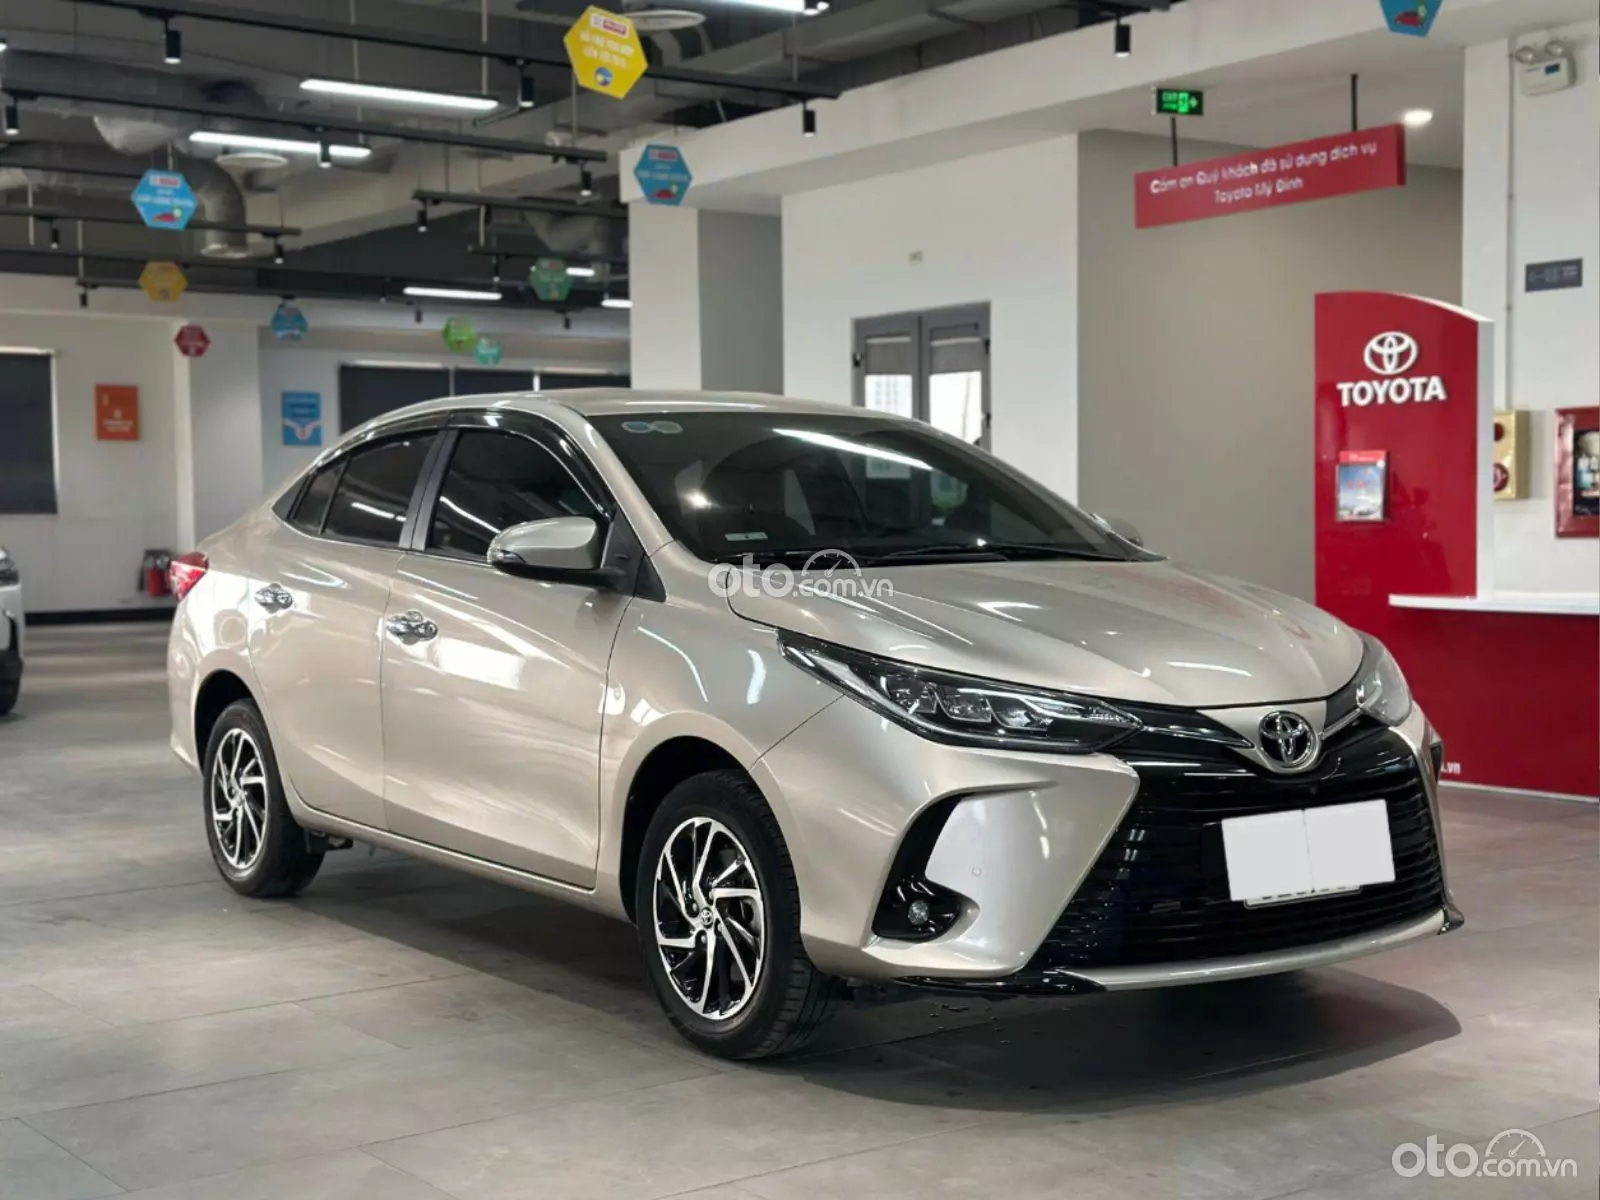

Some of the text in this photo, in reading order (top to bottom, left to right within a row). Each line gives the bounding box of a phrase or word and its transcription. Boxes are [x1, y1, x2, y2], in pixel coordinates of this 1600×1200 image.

[1222, 162, 1258, 181] khách
[1215, 187, 1253, 204] Toyota
[1337, 375, 1447, 407] TOYOTA
